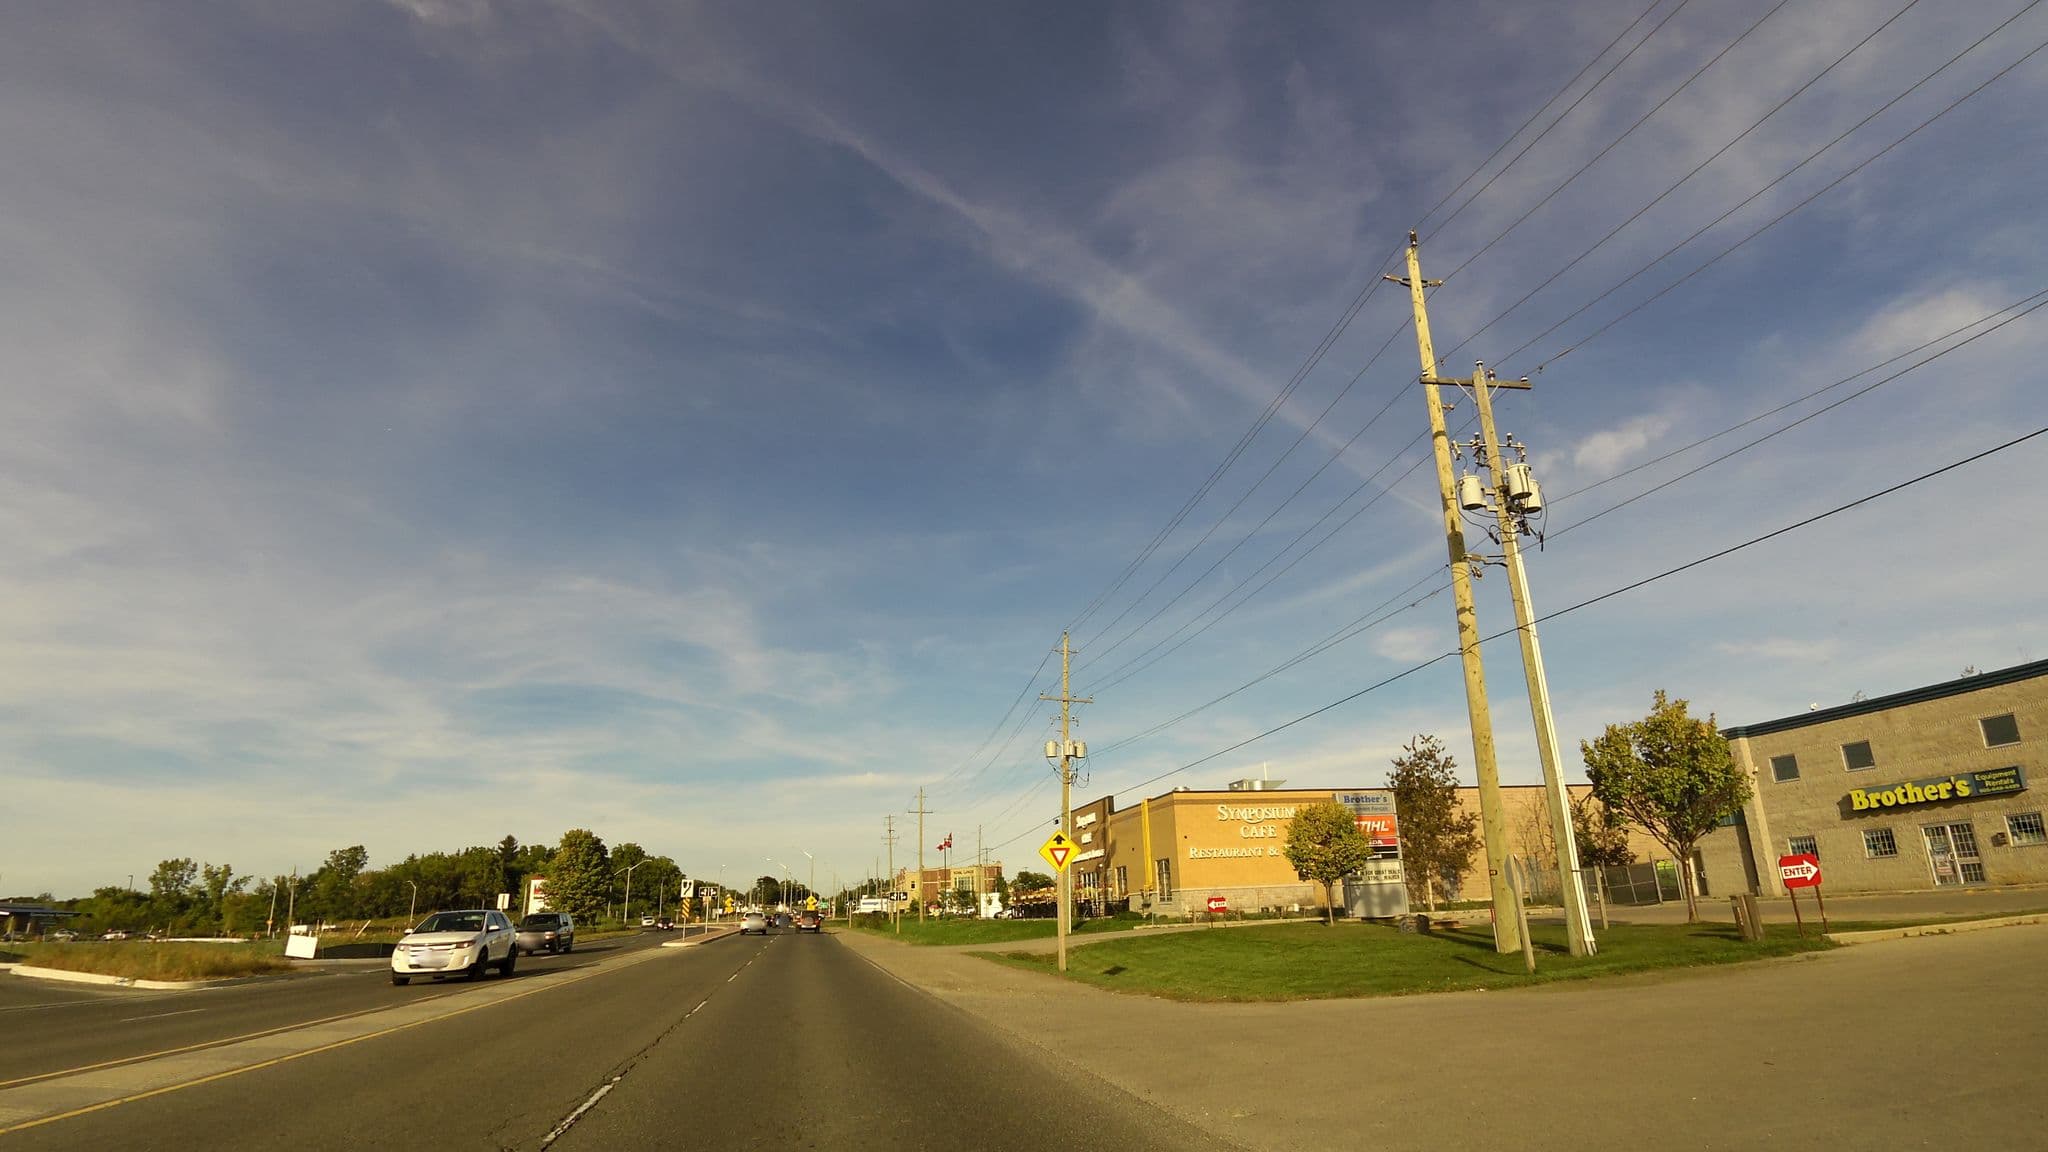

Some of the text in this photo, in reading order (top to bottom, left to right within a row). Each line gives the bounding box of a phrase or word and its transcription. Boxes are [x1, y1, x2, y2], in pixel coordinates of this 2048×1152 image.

[1974, 769, 2017, 781] Equipment
[1985, 778, 2014, 788] Rentals
[1343, 794, 1388, 804] Brother's
[1849, 776, 1971, 811] Brother's
[1217, 804, 1296, 823] SYMPOSIUM
[1240, 825, 1277, 838] CAFE
[1189, 847, 1280, 859] RESTAURANT &
[1783, 866, 1813, 877] ENTER
